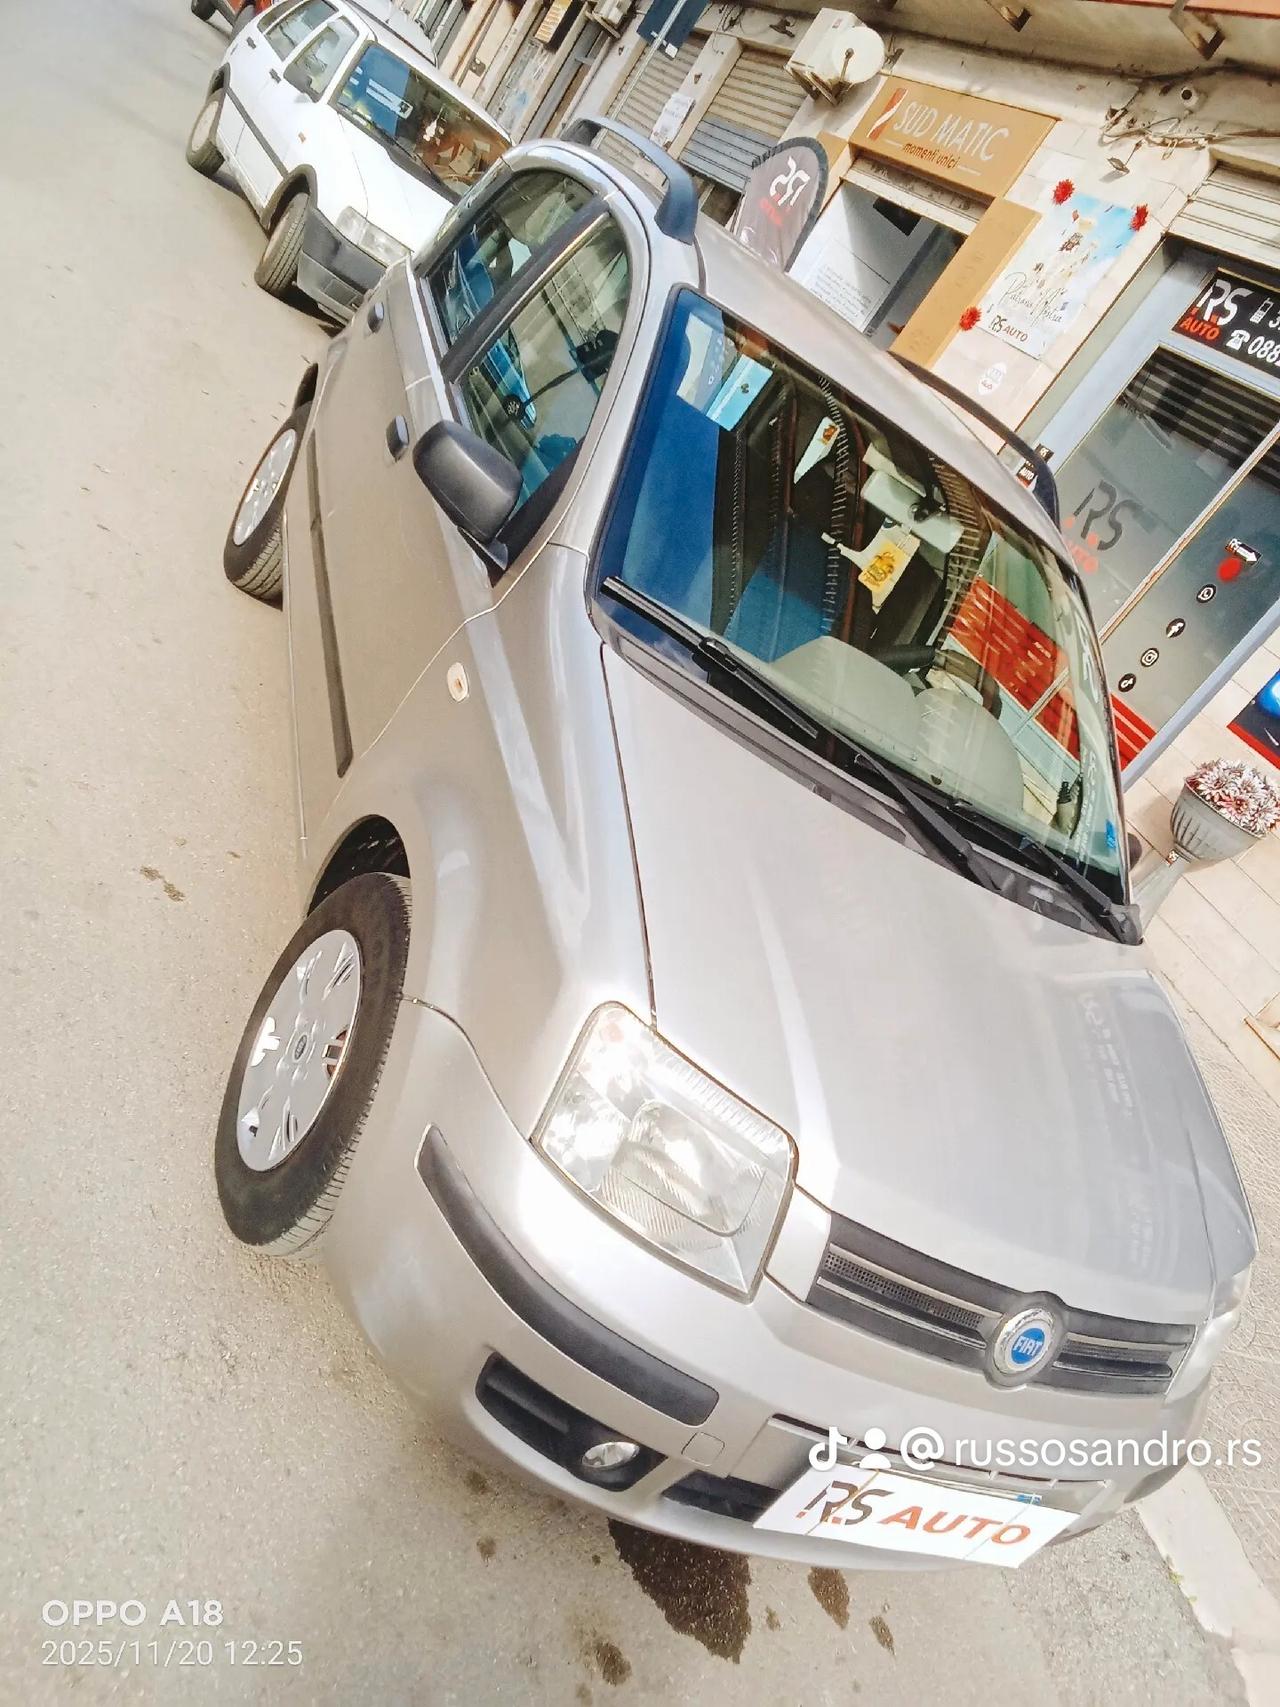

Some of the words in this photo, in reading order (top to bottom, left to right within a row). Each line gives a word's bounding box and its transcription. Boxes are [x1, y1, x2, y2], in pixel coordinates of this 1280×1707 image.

[893, 101, 938, 138] SUD
[930, 113, 1009, 161] MATIC
[903, 143, 939, 162] momenti
[936, 153, 961, 169] unici
[1194, 279, 1255, 326] RS
[1003, 325, 1029, 342] AUTO
[1180, 316, 1221, 340] AUTO
[1247, 335, 1280, 367] 088
[1013, 1335, 1043, 1357] FIAT
[796, 1480, 895, 1526] RS
[877, 1505, 1031, 1544] AUTO
